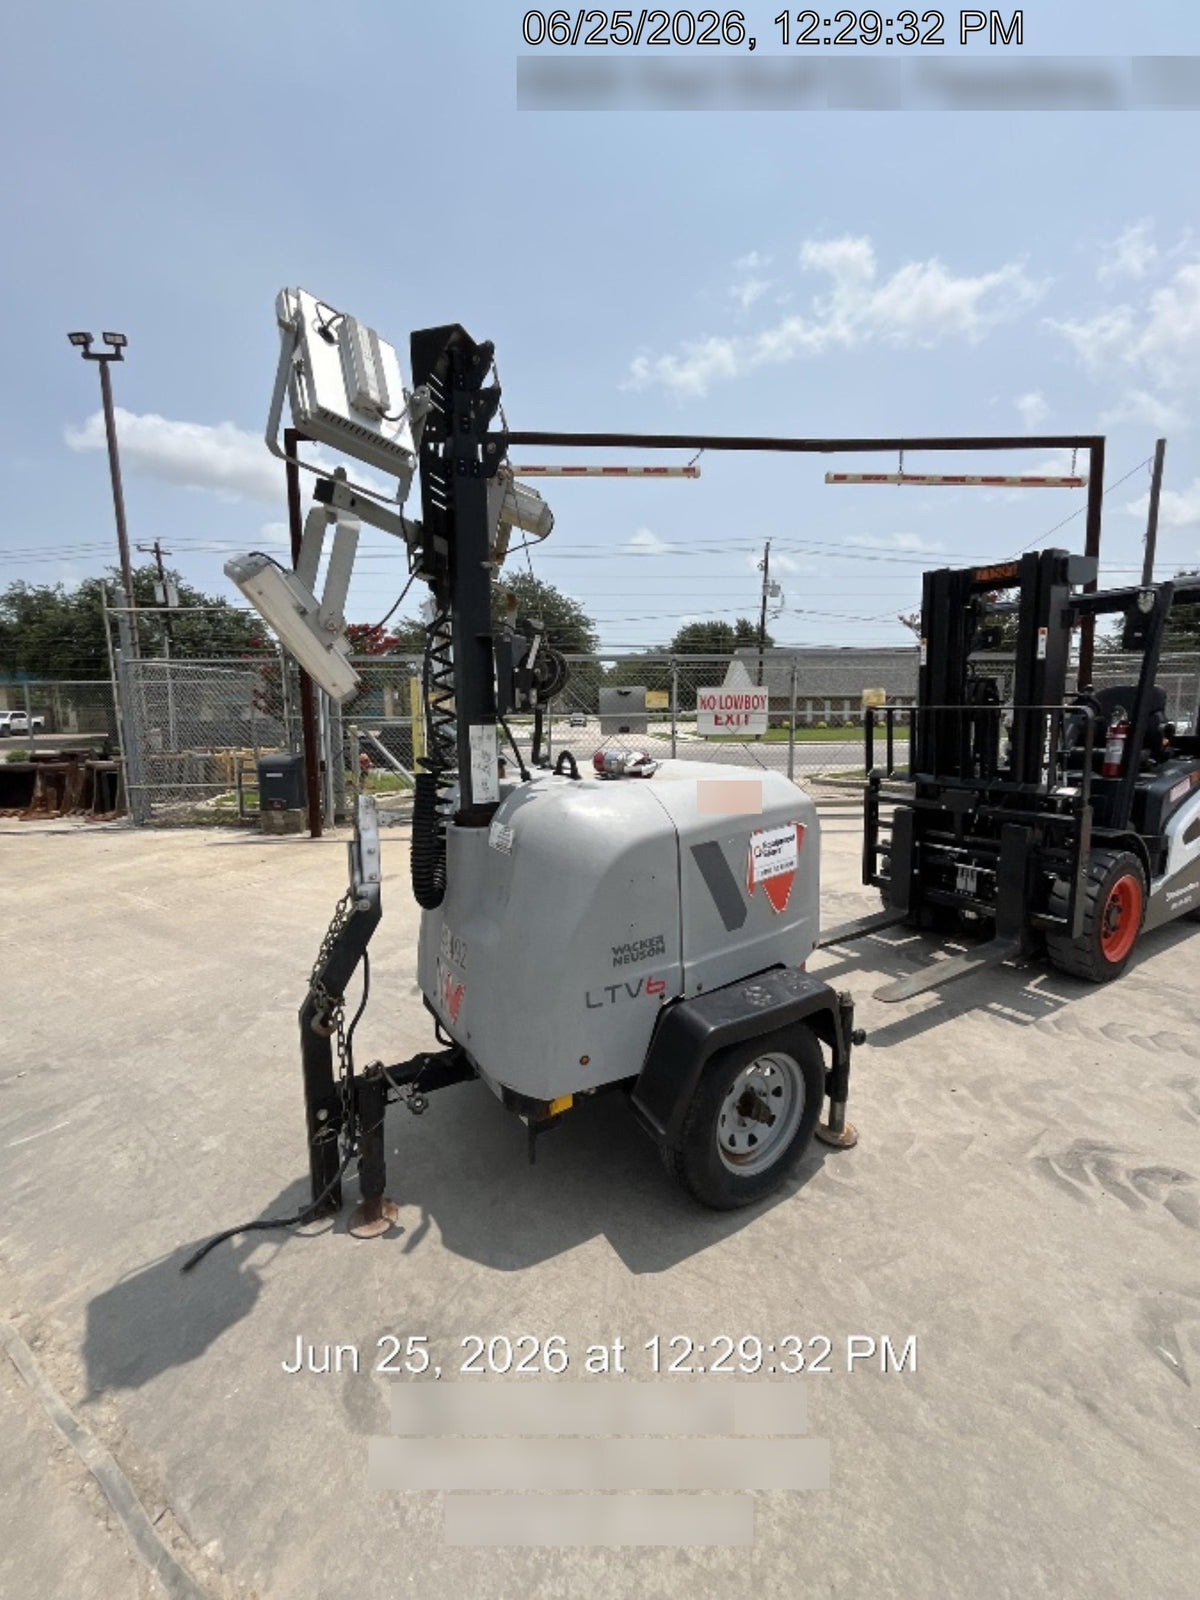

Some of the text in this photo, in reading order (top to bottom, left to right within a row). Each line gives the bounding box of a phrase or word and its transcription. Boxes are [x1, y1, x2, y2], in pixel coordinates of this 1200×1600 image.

[699, 694, 767, 710] NO LOWBOY
[713, 713, 751, 726] EXIT
[611, 935, 664, 956] WACKER
[613, 946, 666, 968] NEUSON
[585, 976, 667, 1009] LTV6
